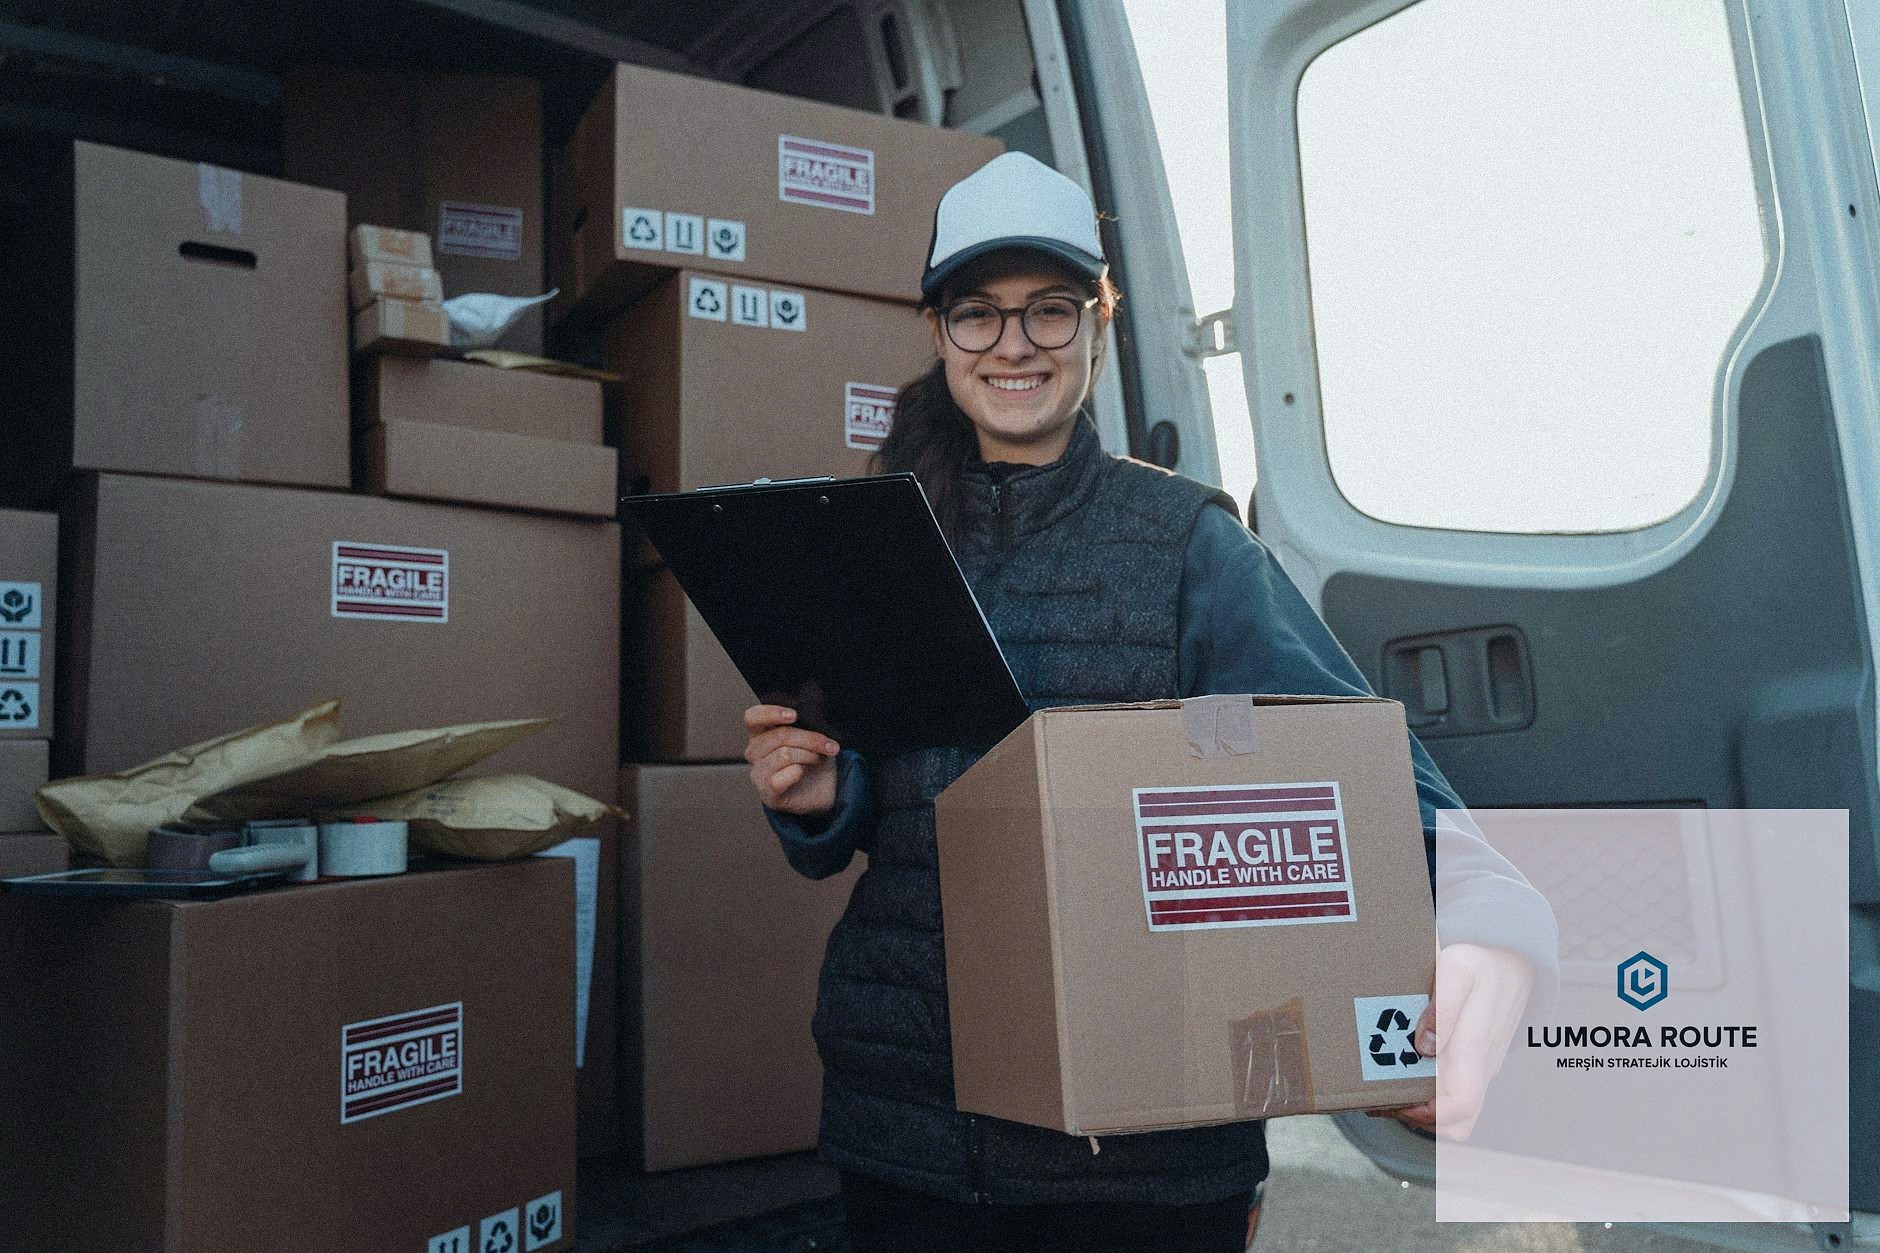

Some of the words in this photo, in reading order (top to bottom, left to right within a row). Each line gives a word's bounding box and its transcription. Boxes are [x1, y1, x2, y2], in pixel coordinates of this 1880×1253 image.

[784, 156, 867, 187] FRAGILE
[338, 565, 442, 593] FRAGILE
[1147, 826, 1338, 868] FRAGILE
[1152, 868, 1231, 888] HANDLE
[1234, 867, 1283, 884] WITH
[1287, 863, 1340, 881] CARE
[347, 1032, 456, 1080] FRAGILE
[348, 1071, 395, 1093] HANDLE
[398, 1064, 425, 1081] WITH
[427, 1056, 456, 1074] CARE
